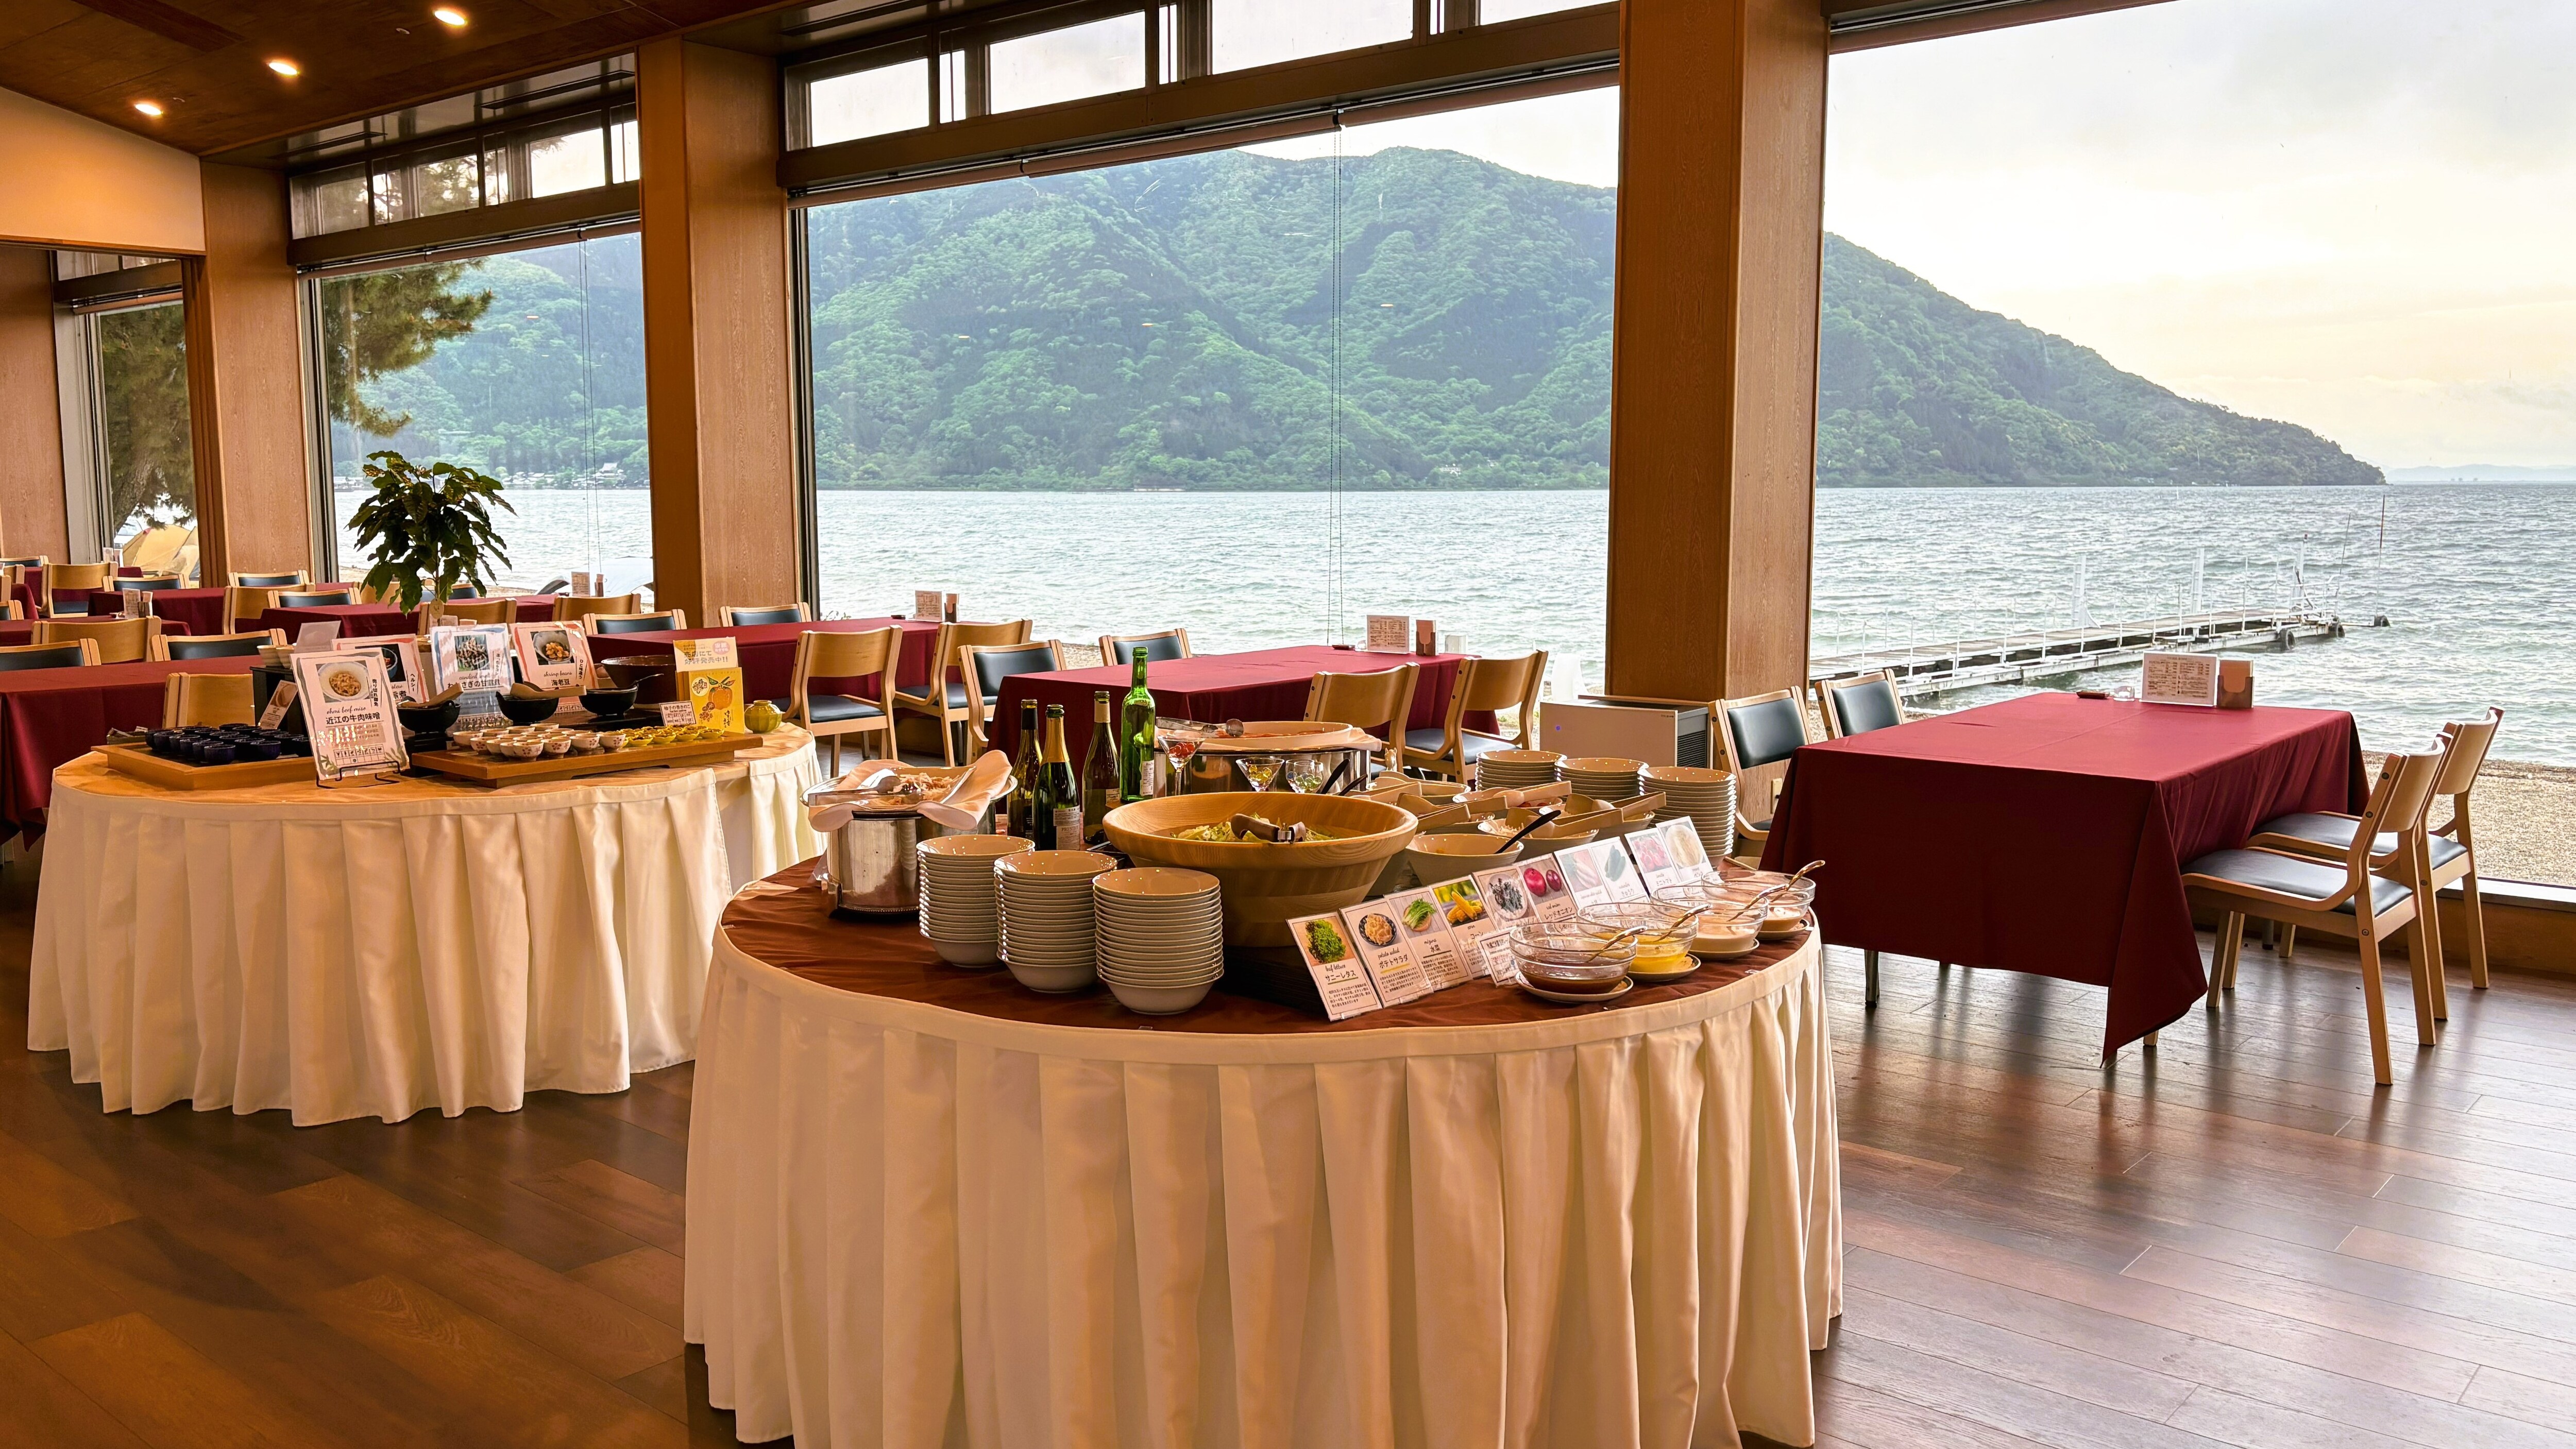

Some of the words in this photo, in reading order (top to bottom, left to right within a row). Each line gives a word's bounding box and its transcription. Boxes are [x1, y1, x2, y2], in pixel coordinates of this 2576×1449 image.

[342, 705, 353, 714] beef
[326, 712, 381, 724] 近江の牛肉味噌
[1544, 907, 1572, 920] レッドオニオン
[1379, 953, 1408, 968] ポテトサラダ
[1325, 970, 1357, 981] サニーレタス
